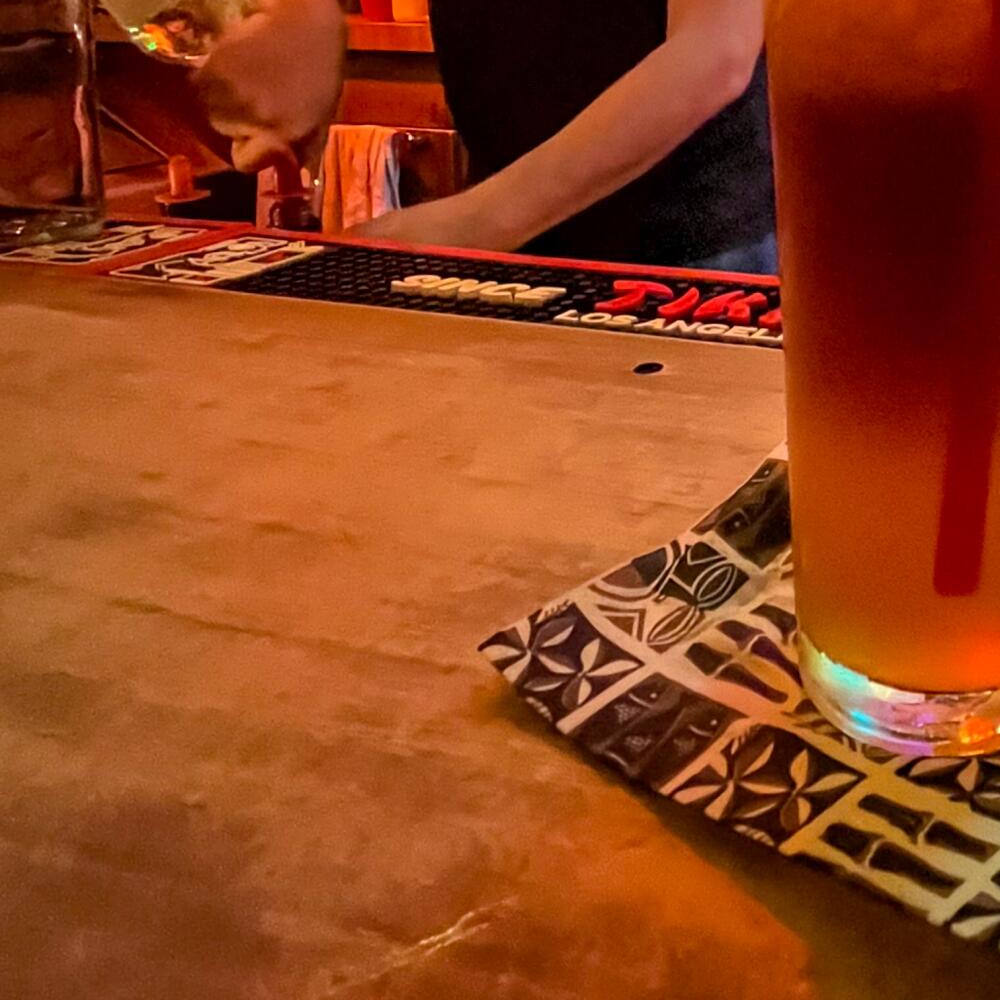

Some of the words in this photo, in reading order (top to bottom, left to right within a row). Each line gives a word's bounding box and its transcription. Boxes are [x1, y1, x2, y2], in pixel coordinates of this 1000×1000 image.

[391, 274, 567, 307] SINCE
[553, 308, 638, 325] LOS
[637, 317, 783, 345] ANGEL
